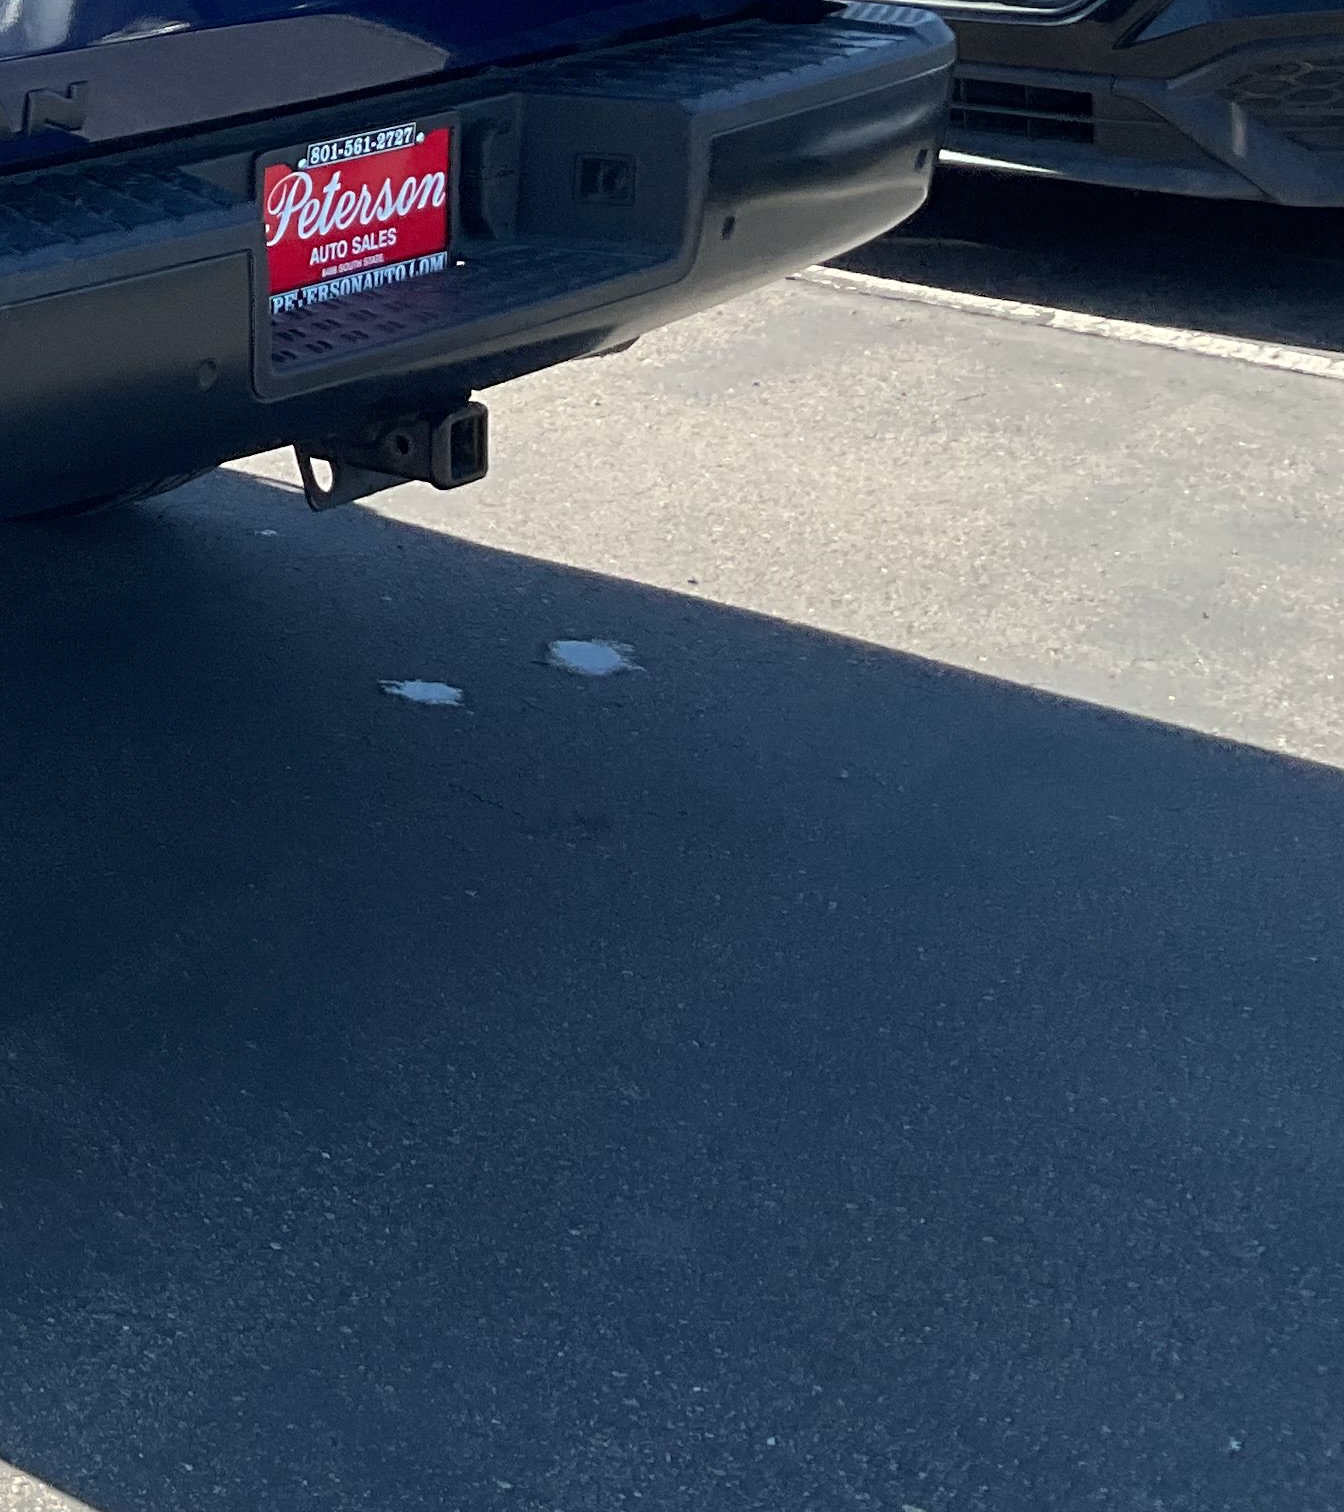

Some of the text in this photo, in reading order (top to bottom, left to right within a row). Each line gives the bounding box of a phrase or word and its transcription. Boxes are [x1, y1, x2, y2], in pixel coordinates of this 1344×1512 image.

[310, 125, 413, 165] 801-561-2727
[266, 171, 446, 247] Peterson
[309, 227, 397, 265] AUTO SALES
